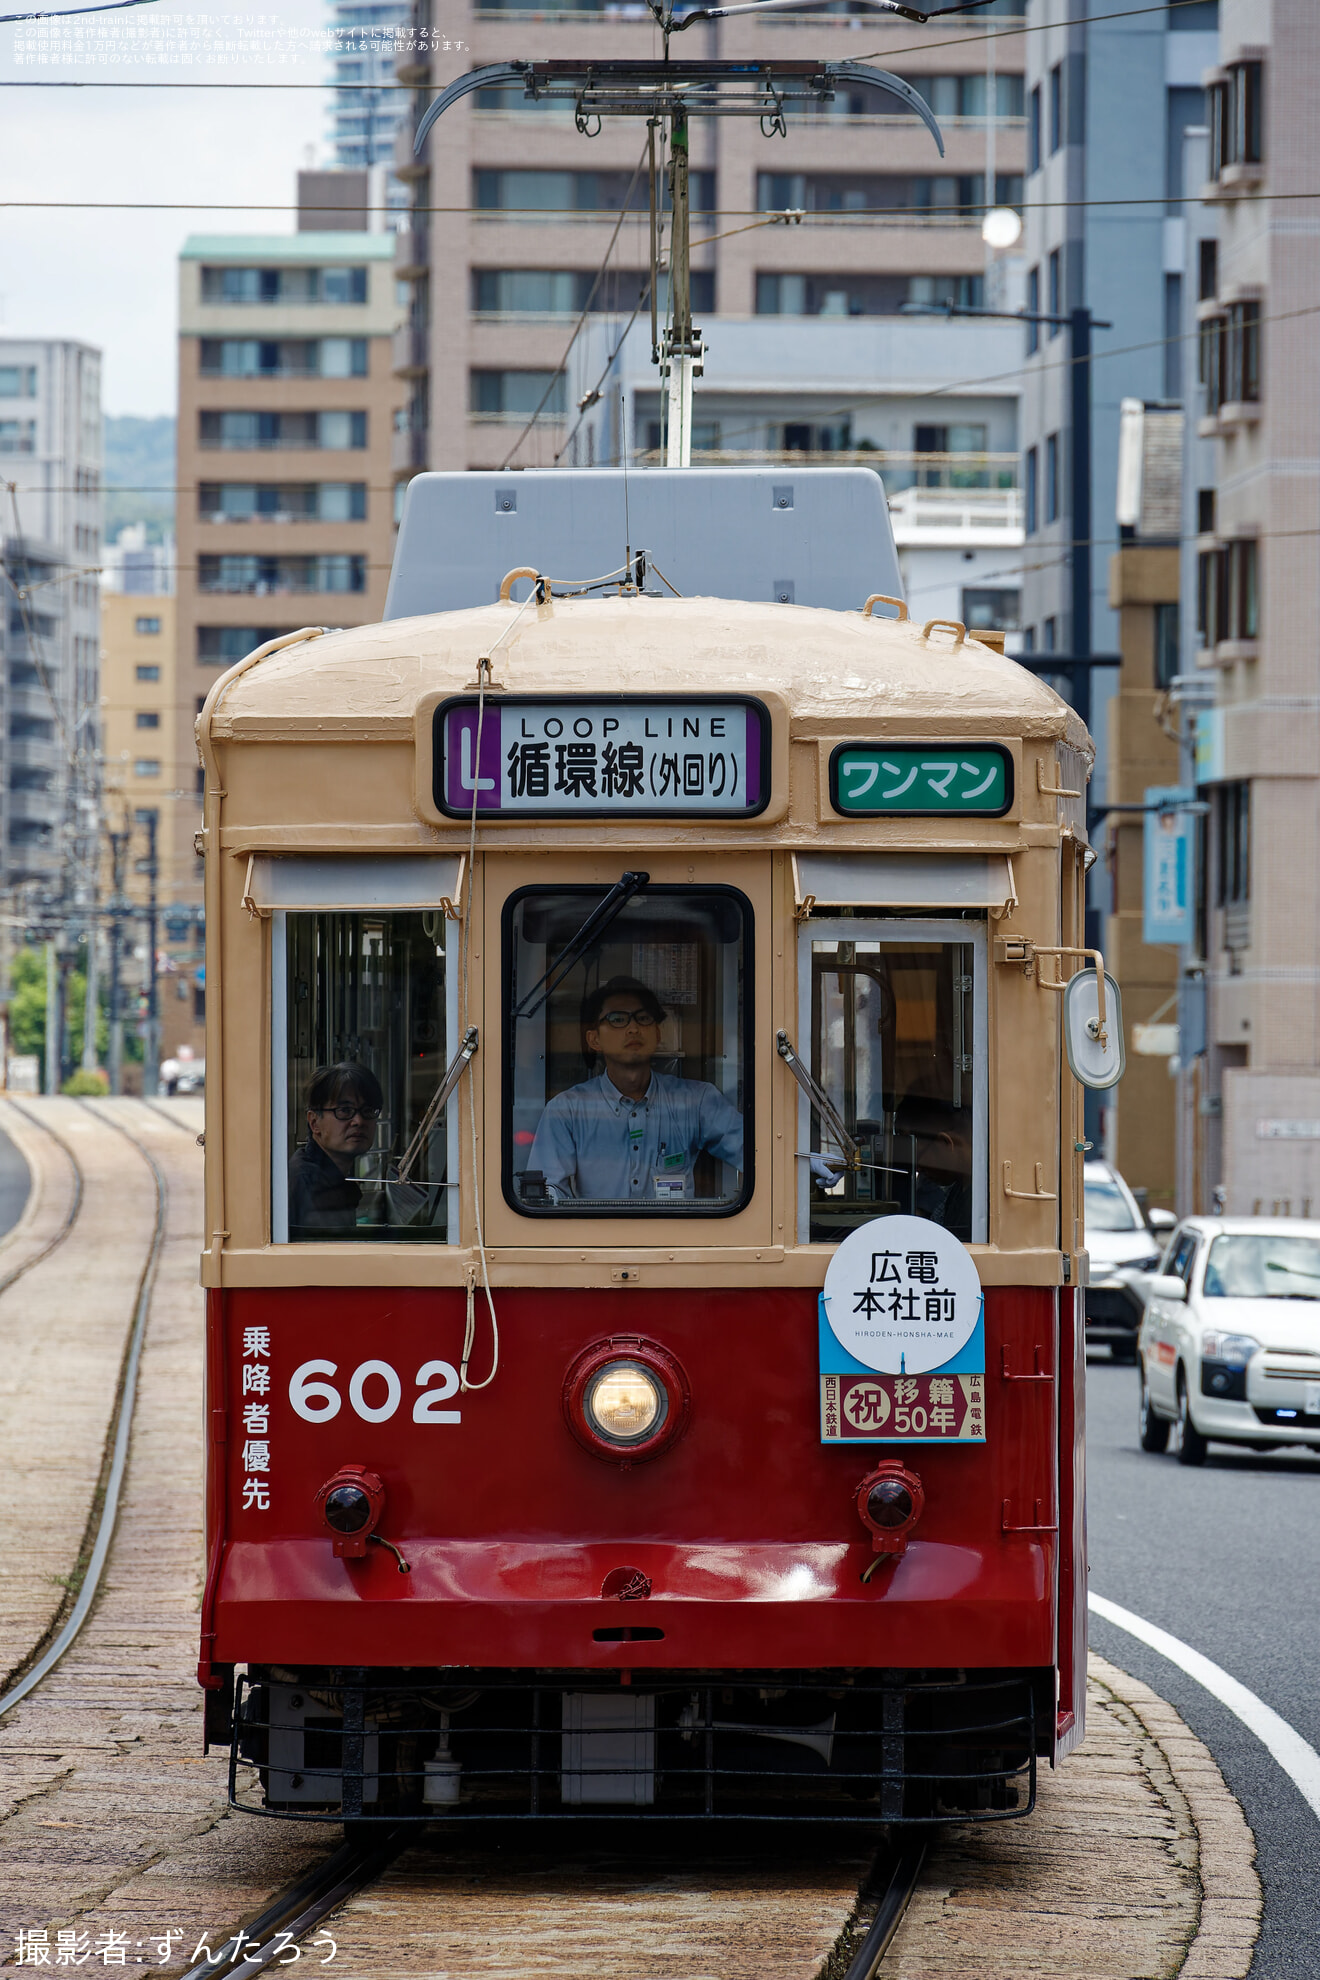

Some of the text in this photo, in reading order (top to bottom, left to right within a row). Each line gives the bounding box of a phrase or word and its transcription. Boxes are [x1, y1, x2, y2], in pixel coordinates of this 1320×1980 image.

[521, 717, 726, 739] LOOP LINE
[460, 726, 496, 791] L
[507, 740, 738, 799] 循環線(外回り)
[842, 761, 998, 799] ワンマン
[869, 1249, 940, 1285] 広電
[852, 1287, 957, 1322] 本社前
[855, 1330, 955, 1339] HIRODEN-HONSHA-MAE
[288, 1359, 462, 1424] 602
[825, 1376, 838, 1438] 西日本鉄道
[849, 1389, 884, 1425] 祝
[893, 1378, 955, 1405] 移籍
[969, 1374, 983, 1436] 広島電鉄
[242, 1326, 271, 1510] 乗降者優先
[894, 1407, 957, 1434] 50年
